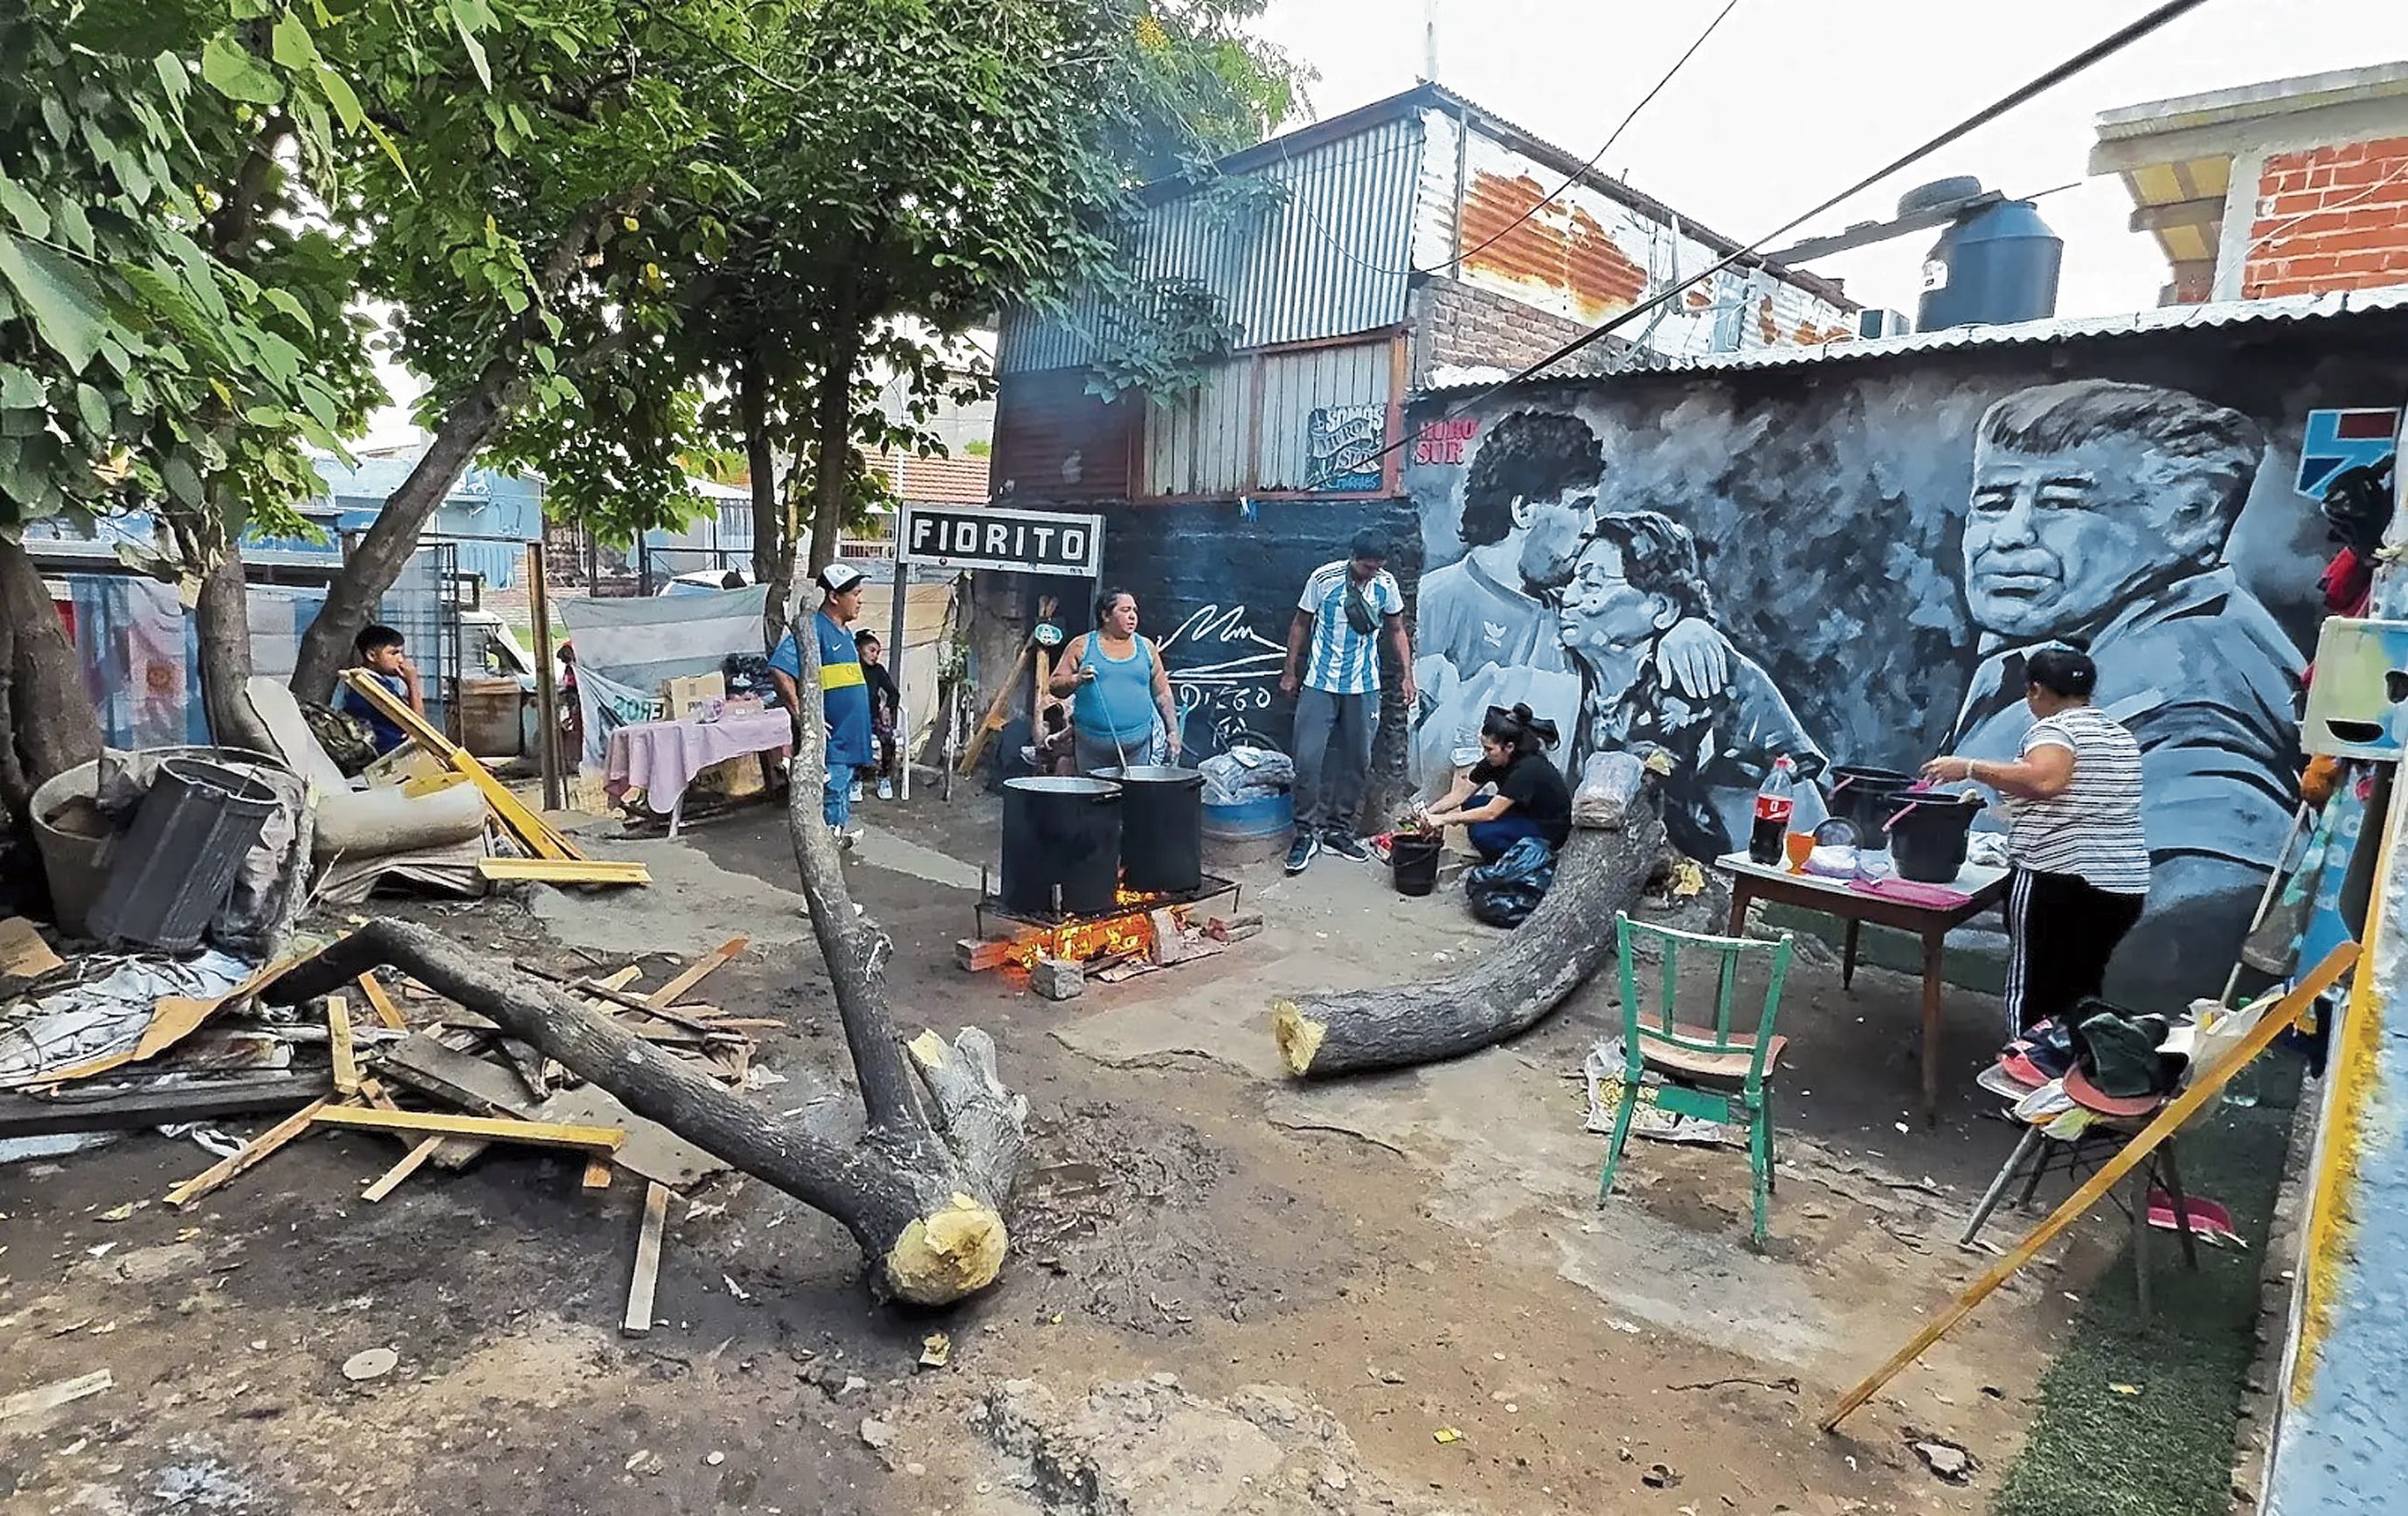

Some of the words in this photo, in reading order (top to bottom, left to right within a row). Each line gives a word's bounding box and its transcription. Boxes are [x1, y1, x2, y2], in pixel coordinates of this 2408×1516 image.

[1326, 405, 1385, 433] SOMOS
[1415, 440, 1465, 466] SUR
[913, 518, 1087, 561] FIORITO
[1176, 683, 1271, 716] DIEGO
